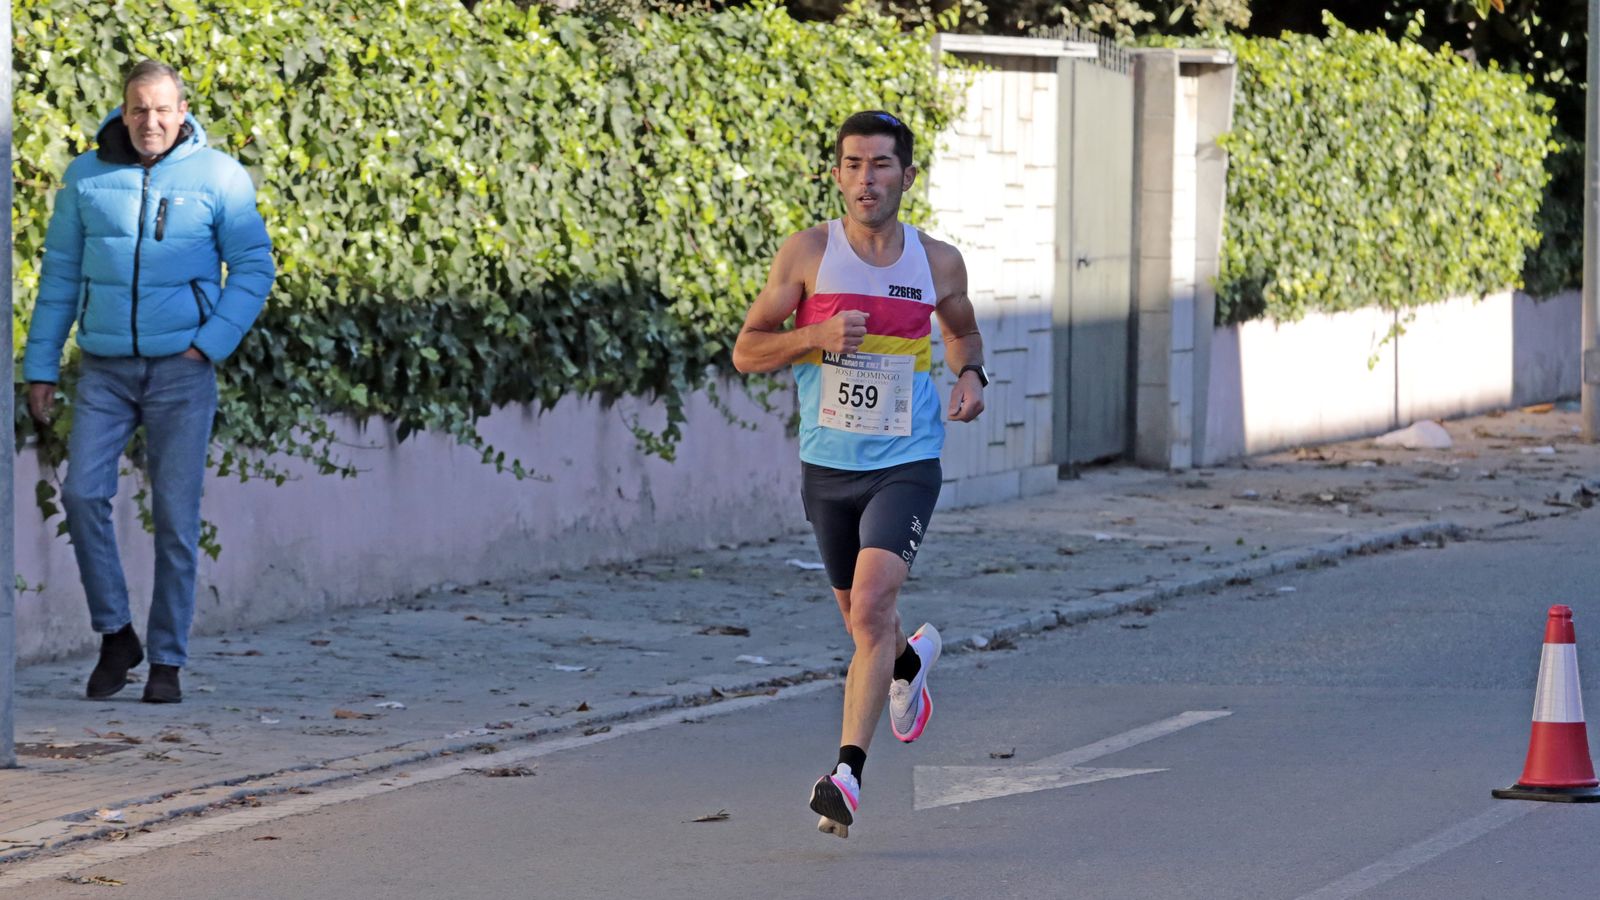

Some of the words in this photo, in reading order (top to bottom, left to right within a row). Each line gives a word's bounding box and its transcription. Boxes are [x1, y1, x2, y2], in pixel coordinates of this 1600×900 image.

[888, 285, 922, 300] 226ERS
[835, 368, 854, 376] JOSE
[857, 371, 900, 380] DOMINGO
[838, 382, 878, 409] 559
